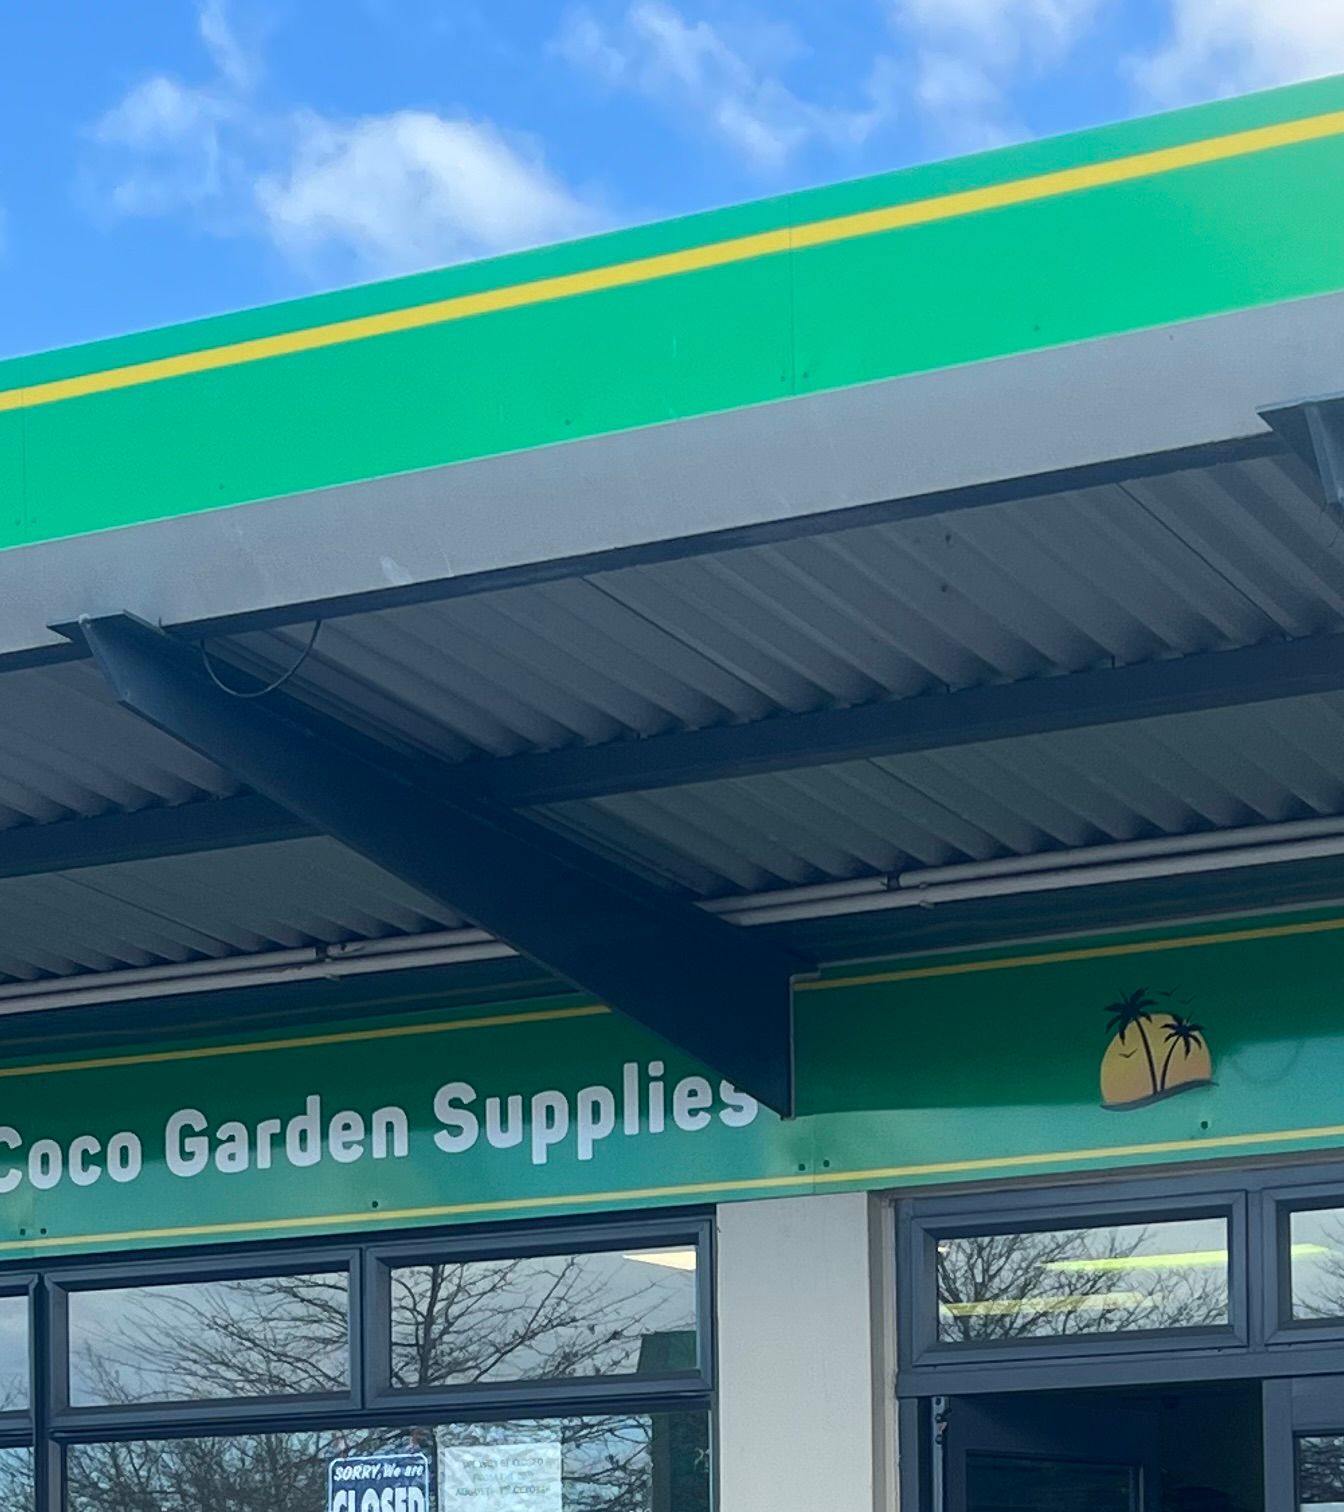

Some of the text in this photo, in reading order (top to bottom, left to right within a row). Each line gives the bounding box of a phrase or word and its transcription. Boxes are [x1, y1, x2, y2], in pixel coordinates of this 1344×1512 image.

[164, 1093, 411, 1178] Garden
[432, 1059, 760, 1166] Supplies
[333, 1463, 381, 1482] SORRY,
